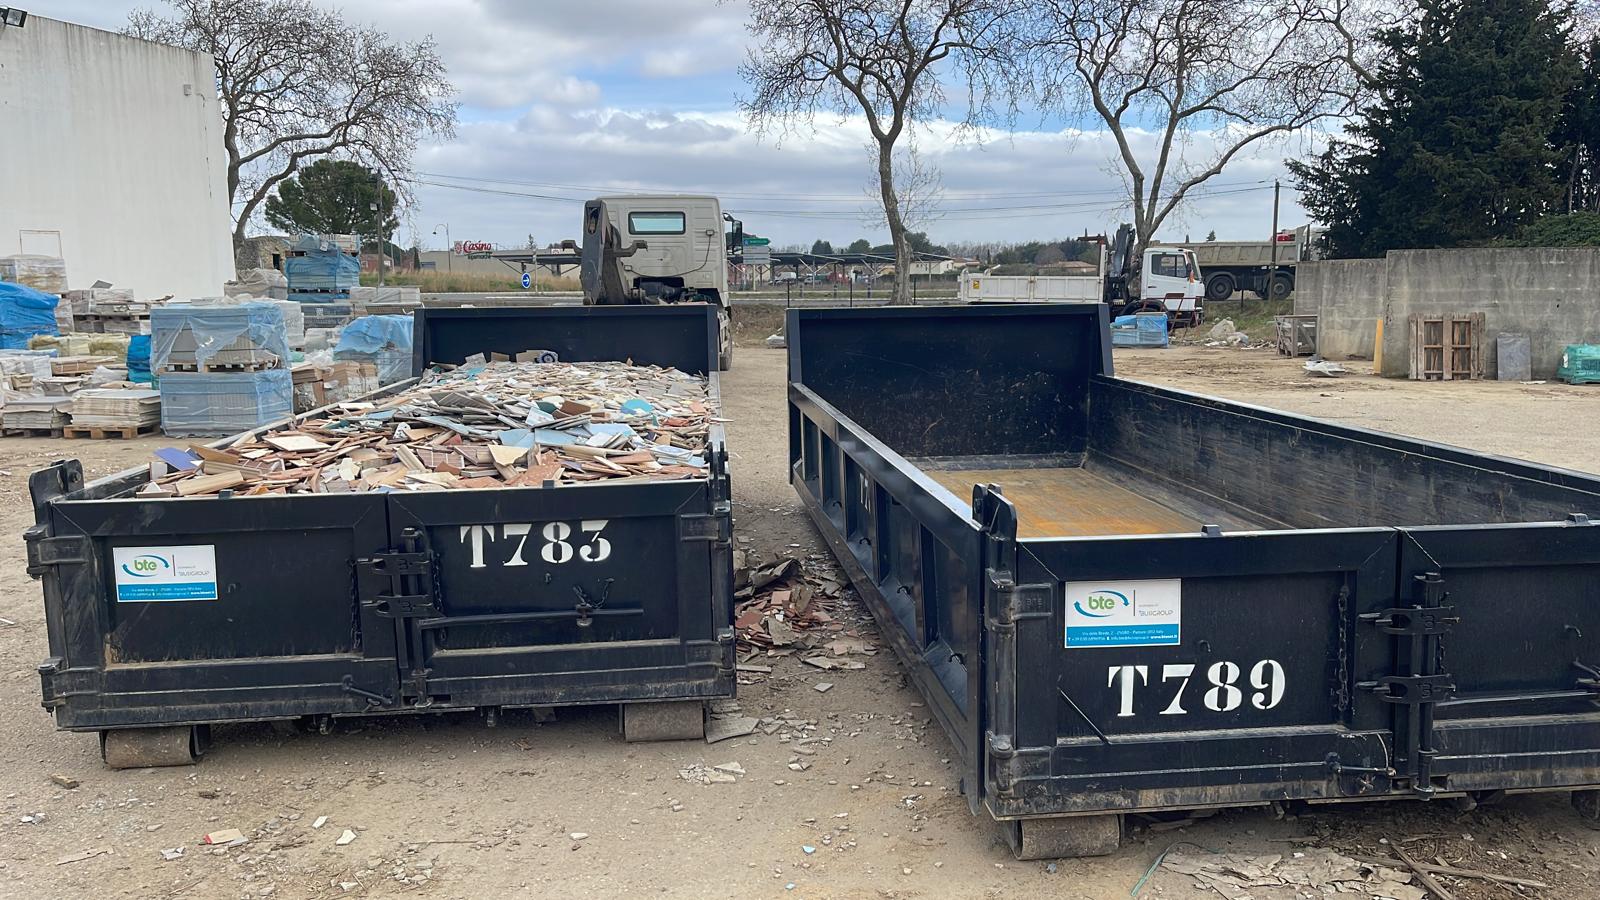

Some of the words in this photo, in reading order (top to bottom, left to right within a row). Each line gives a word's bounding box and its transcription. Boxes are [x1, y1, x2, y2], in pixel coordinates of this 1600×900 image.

[463, 240, 491, 253] Casino
[460, 519, 611, 568] T783
[134, 559, 157, 571] bte
[1088, 596, 1115, 610] bte
[1107, 659, 1286, 717] T789
